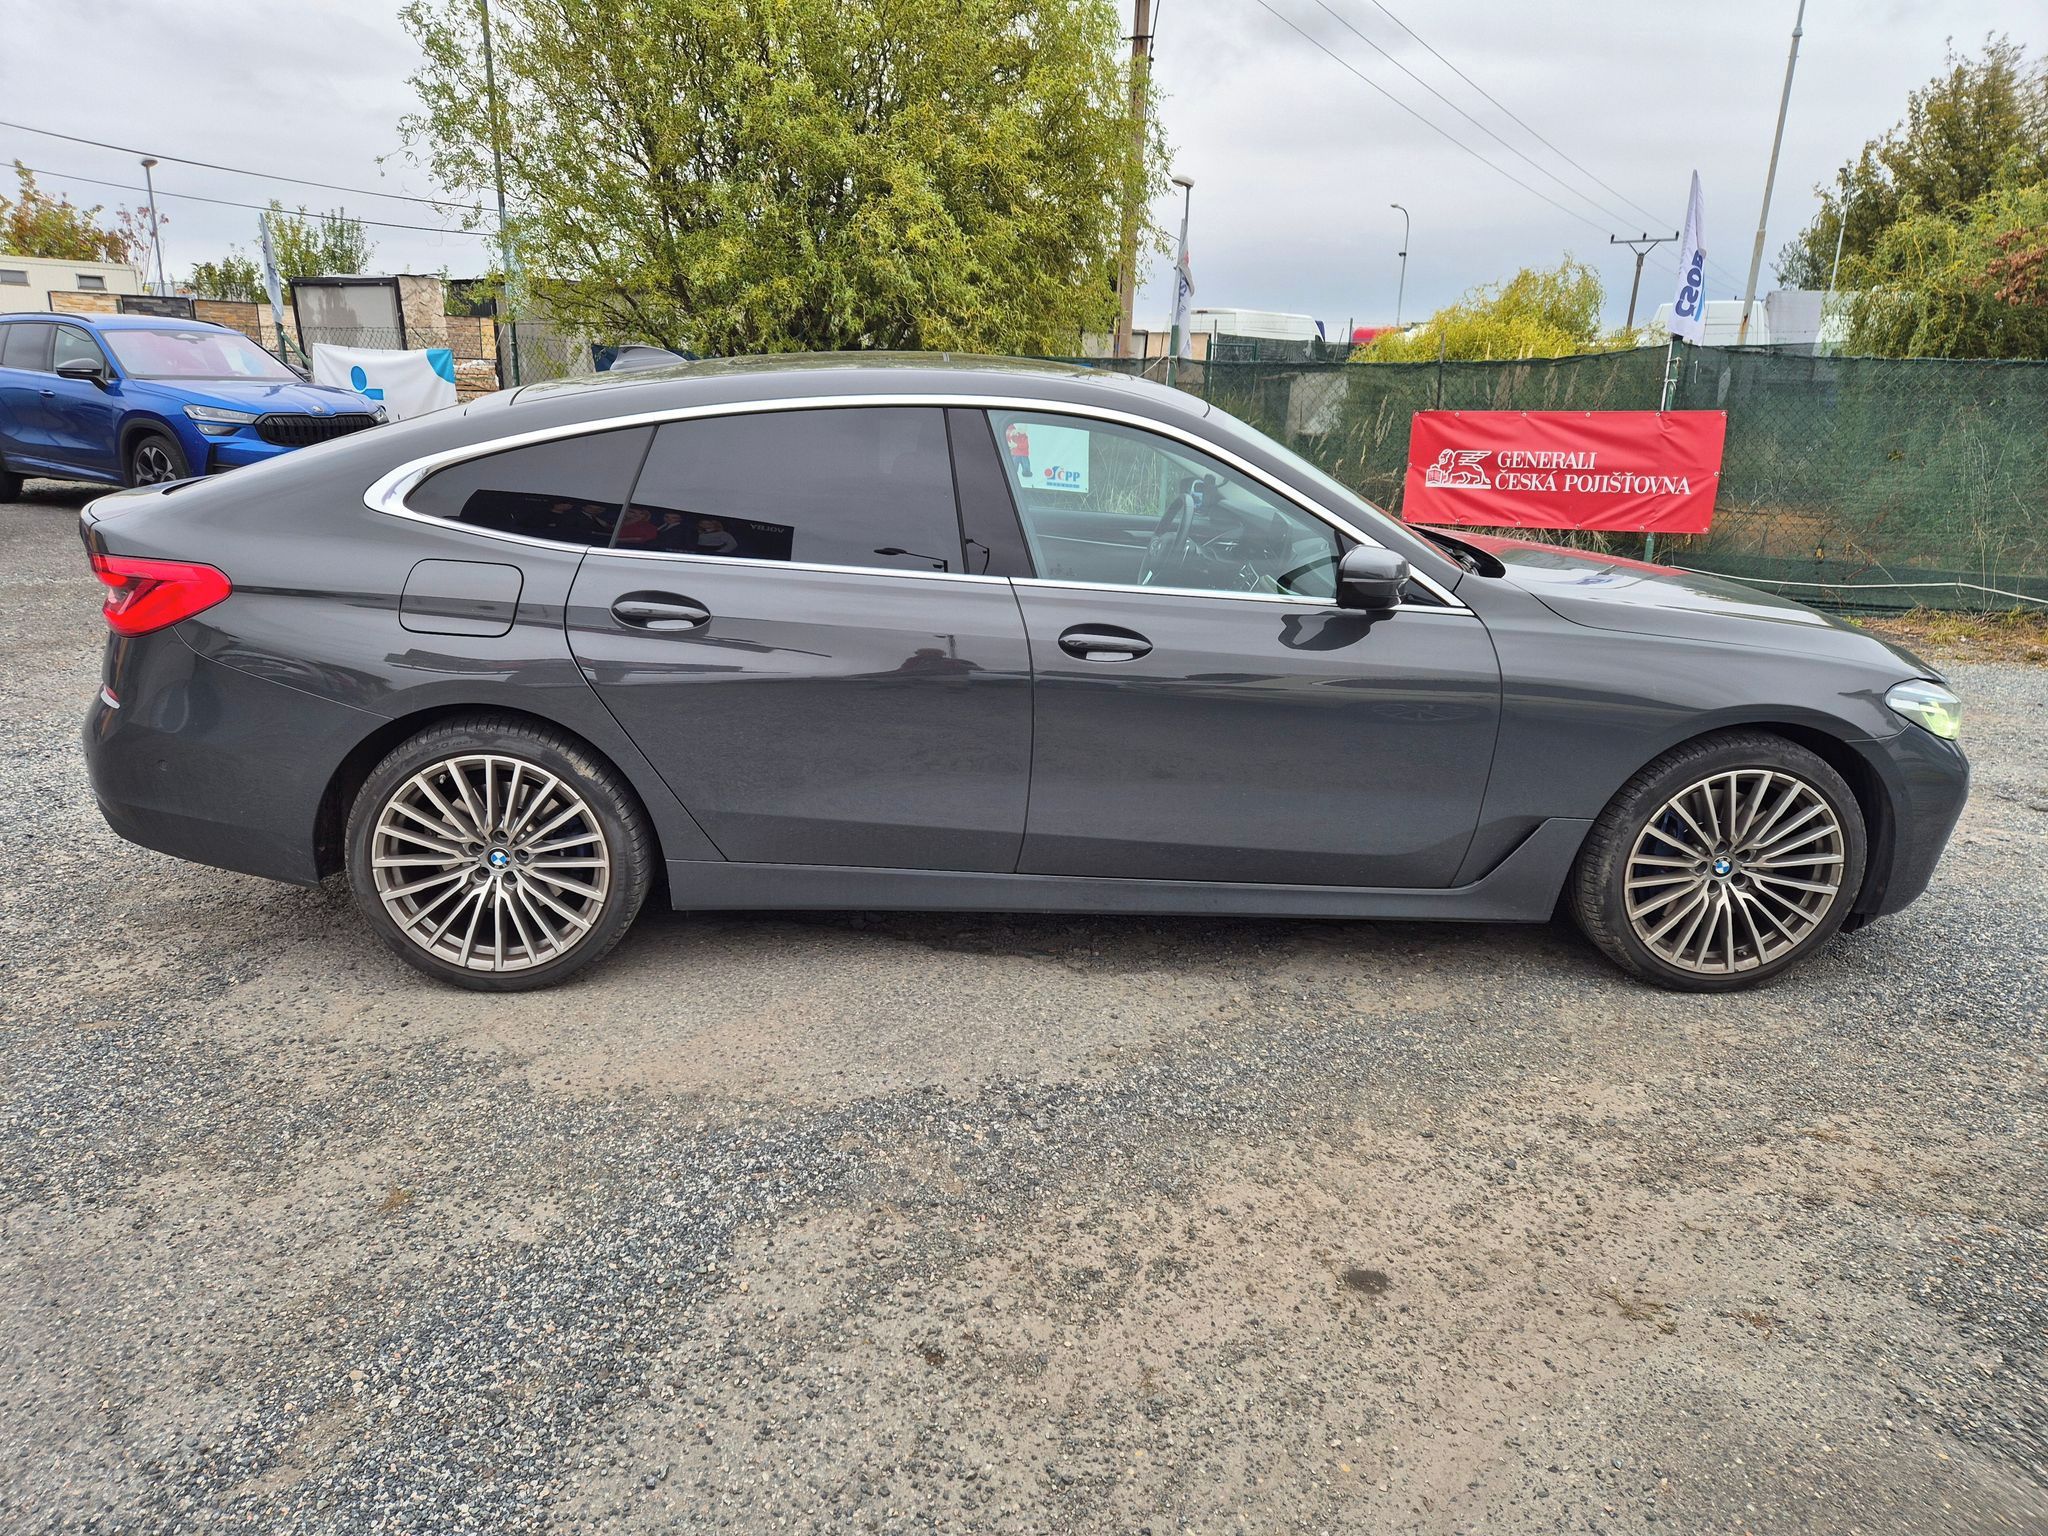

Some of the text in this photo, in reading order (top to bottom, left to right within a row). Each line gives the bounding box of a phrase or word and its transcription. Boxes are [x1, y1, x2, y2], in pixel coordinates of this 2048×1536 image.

[1497, 450, 1597, 470] GENERALI
[1057, 467, 1080, 482] ČPP
[1495, 470, 1692, 495] ČESKÁ POJIŠŤOVNA
